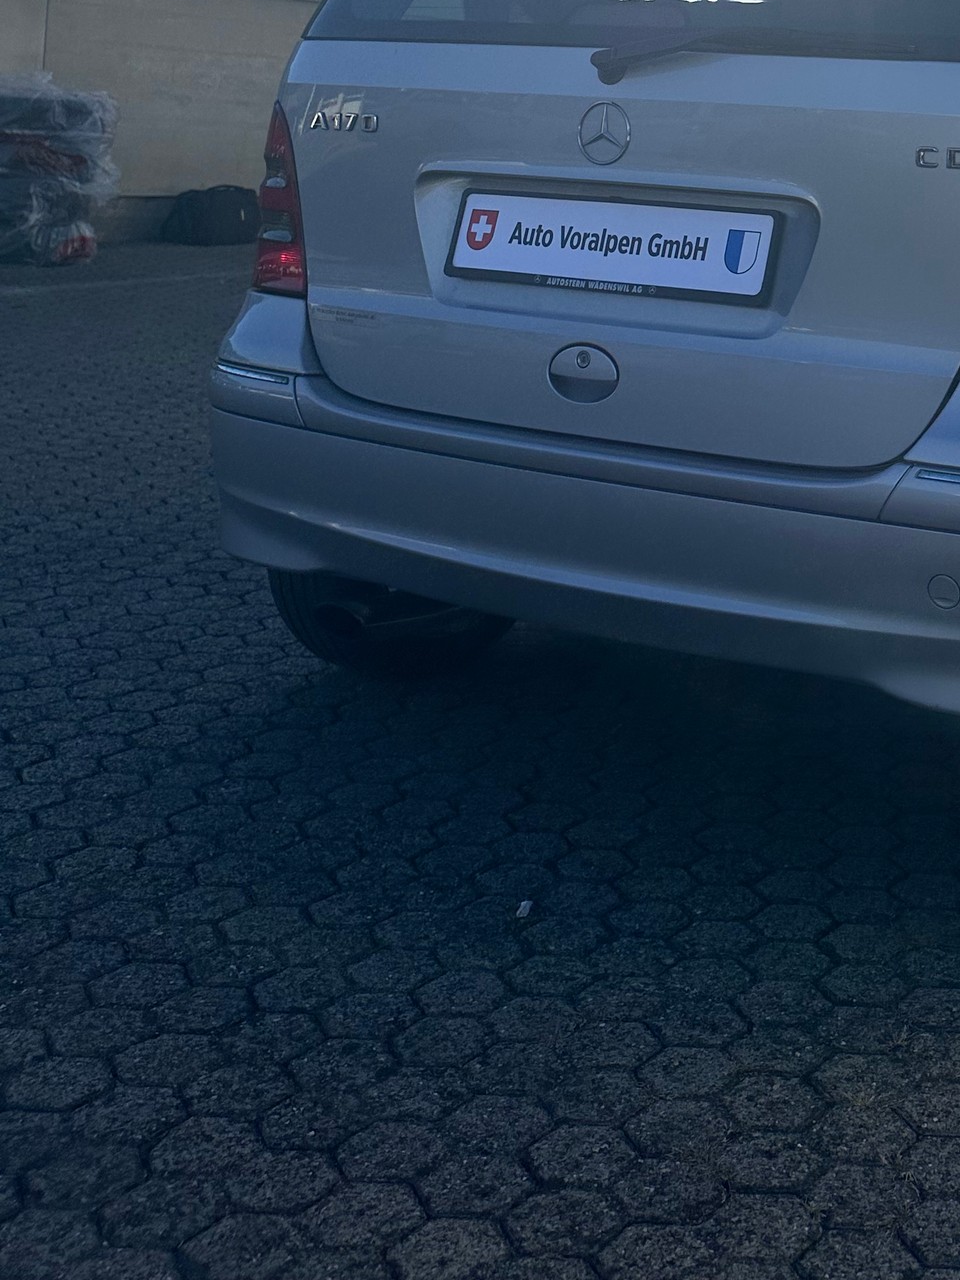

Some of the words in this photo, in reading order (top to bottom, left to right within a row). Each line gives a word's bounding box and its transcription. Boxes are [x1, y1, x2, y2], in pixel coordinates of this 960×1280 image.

[508, 221, 554, 248] Auto
[560, 225, 642, 257] Voralpen
[647, 233, 709, 261] GmbH
[546, 277, 586, 288] AUTOSTERN
[588, 280, 630, 293] WÄDENSWIL
[631, 285, 643, 293] AG
